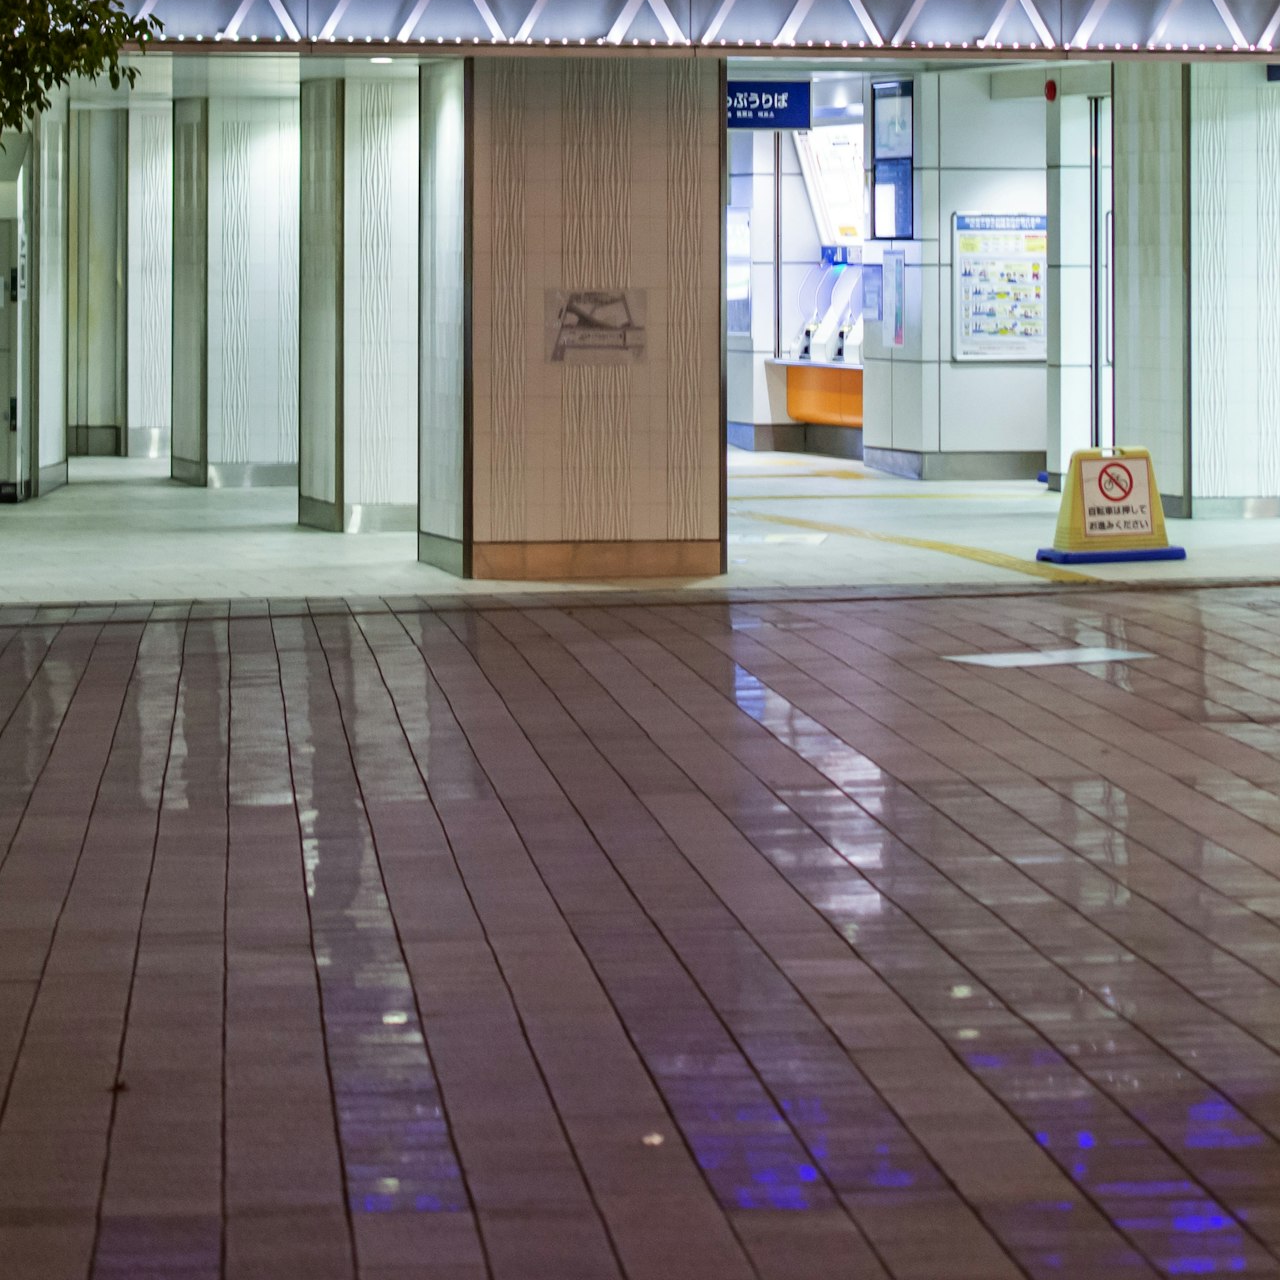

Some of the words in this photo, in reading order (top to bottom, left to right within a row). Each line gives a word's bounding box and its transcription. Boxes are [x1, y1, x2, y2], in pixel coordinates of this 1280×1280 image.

[1088, 505, 1146, 516] 自転車は押して
